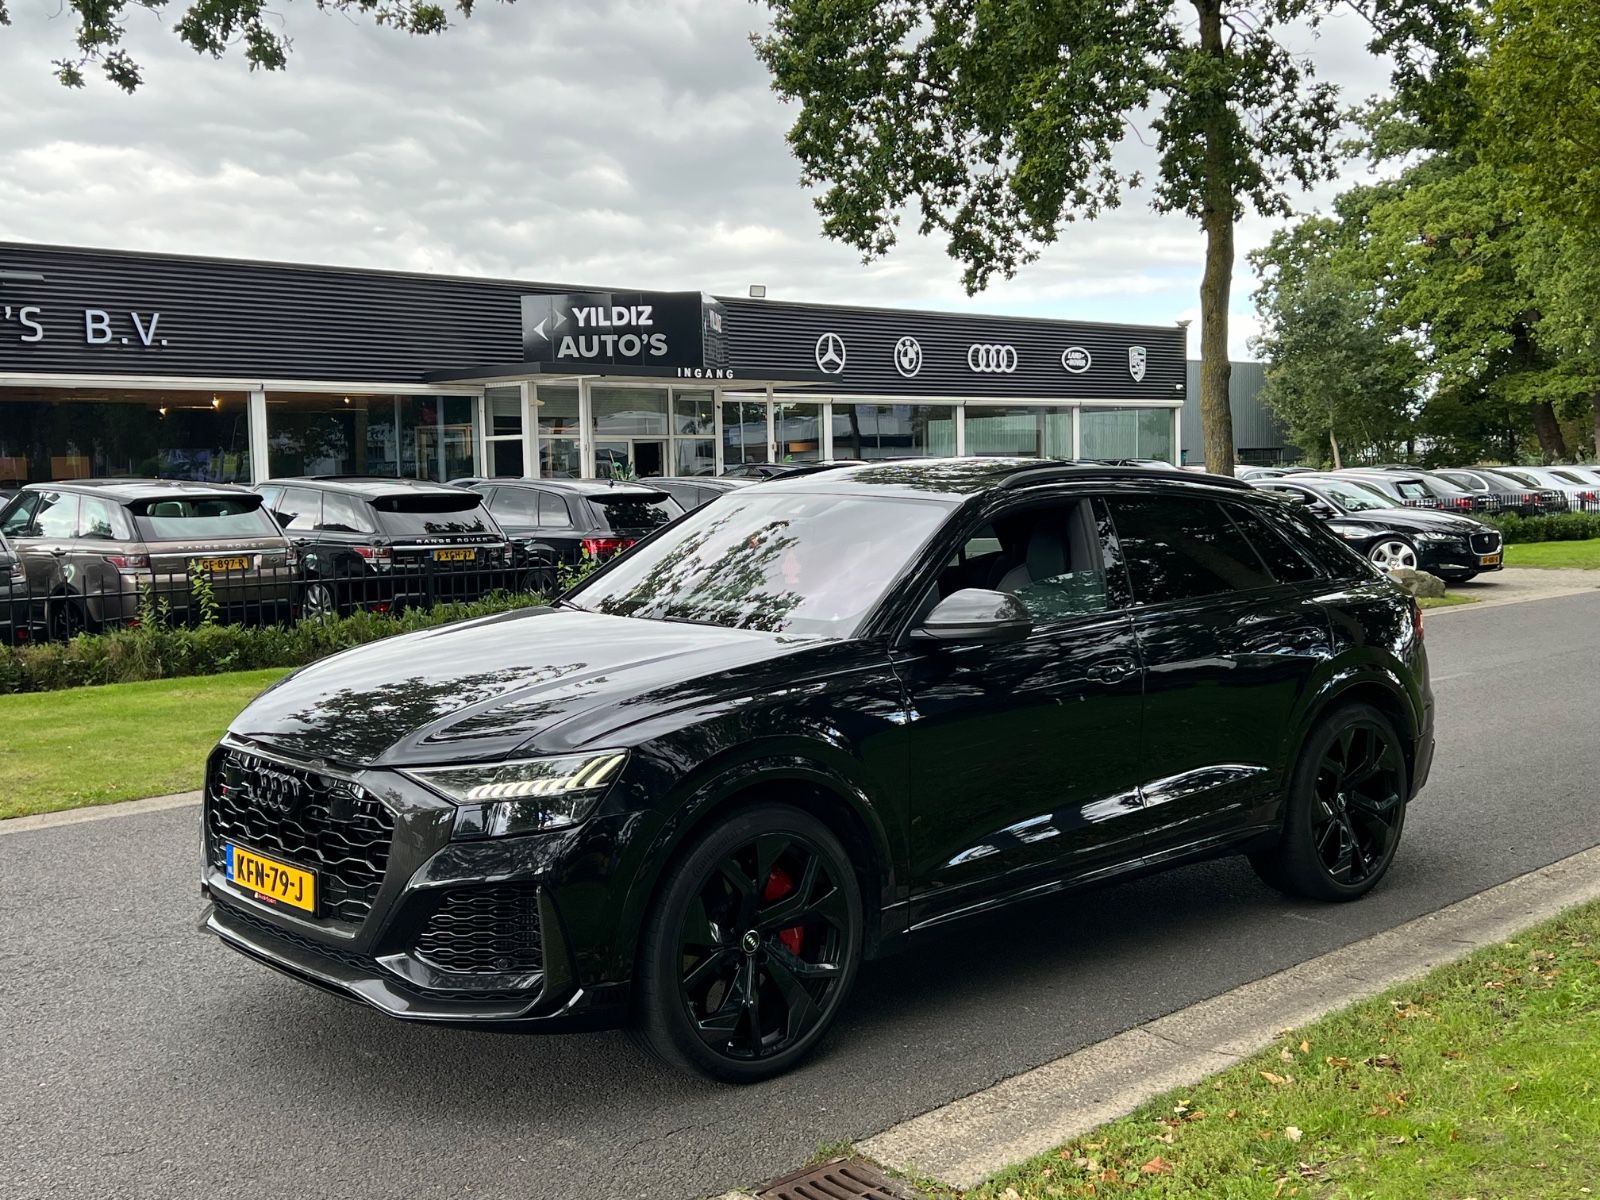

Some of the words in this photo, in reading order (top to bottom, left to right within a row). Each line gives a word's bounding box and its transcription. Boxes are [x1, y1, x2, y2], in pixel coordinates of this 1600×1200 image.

[85, 309, 168, 346] B.V.
[571, 305, 653, 327] YILDIZ
[557, 333, 669, 359] AUTO'S
[677, 367, 734, 379] INGANG
[236, 853, 303, 902] KFN-79-J
